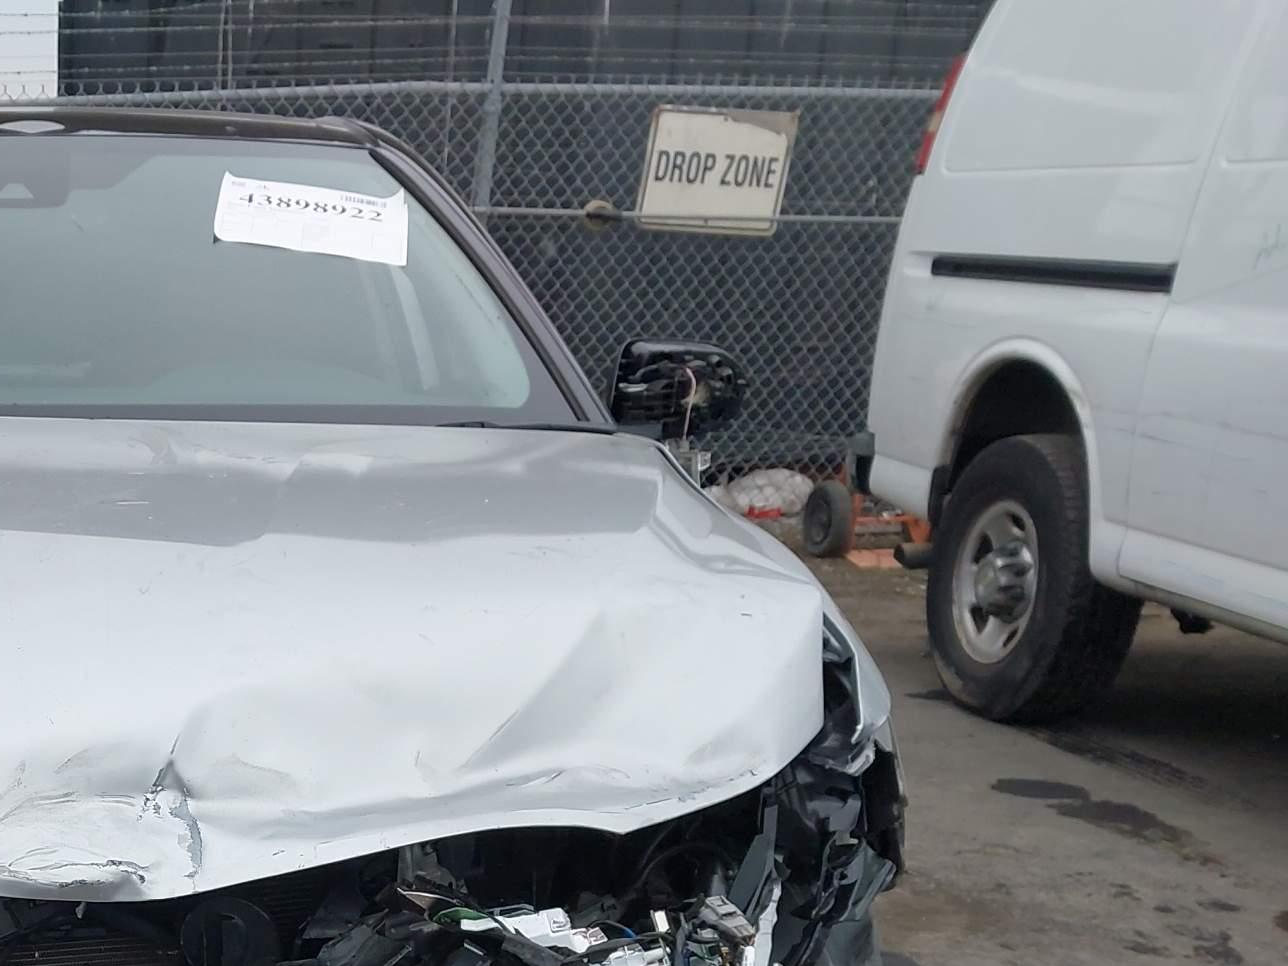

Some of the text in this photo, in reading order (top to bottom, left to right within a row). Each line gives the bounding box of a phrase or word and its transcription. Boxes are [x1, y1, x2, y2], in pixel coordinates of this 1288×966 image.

[654, 150, 779, 188] DROP ZONE
[239, 193, 383, 222] 43898922
